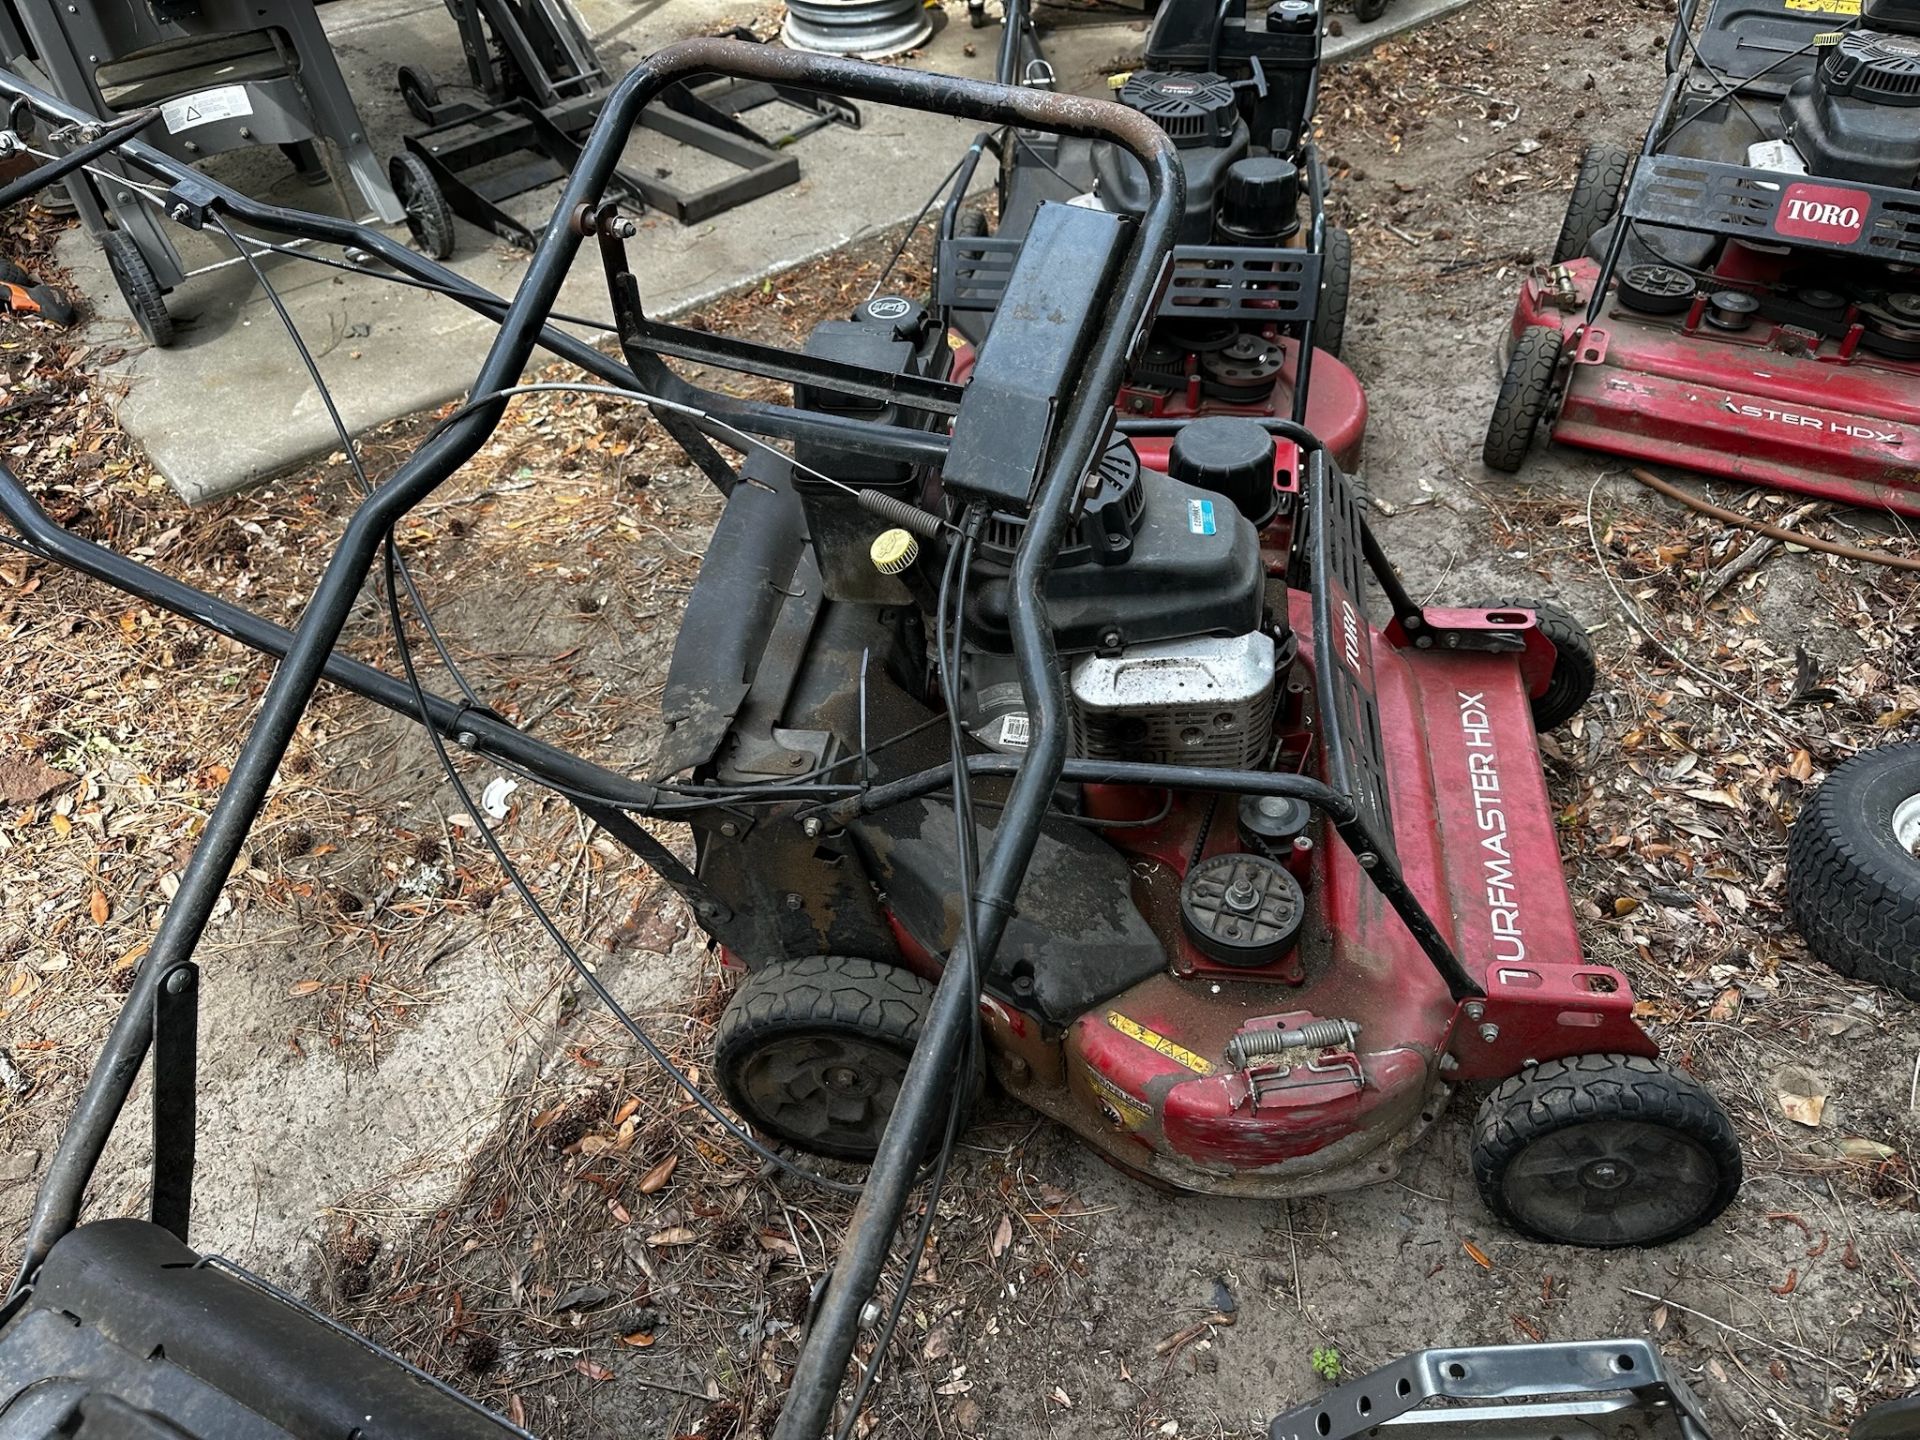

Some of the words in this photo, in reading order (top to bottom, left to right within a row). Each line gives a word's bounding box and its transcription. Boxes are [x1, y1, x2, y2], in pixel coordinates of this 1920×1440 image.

[1787, 198, 1860, 229] TORO
[1830, 422, 1896, 442] HDX
[1342, 600, 1361, 674] TORO
[1458, 690, 1493, 748] HDX
[1468, 752, 1530, 985] TURFMASTER
